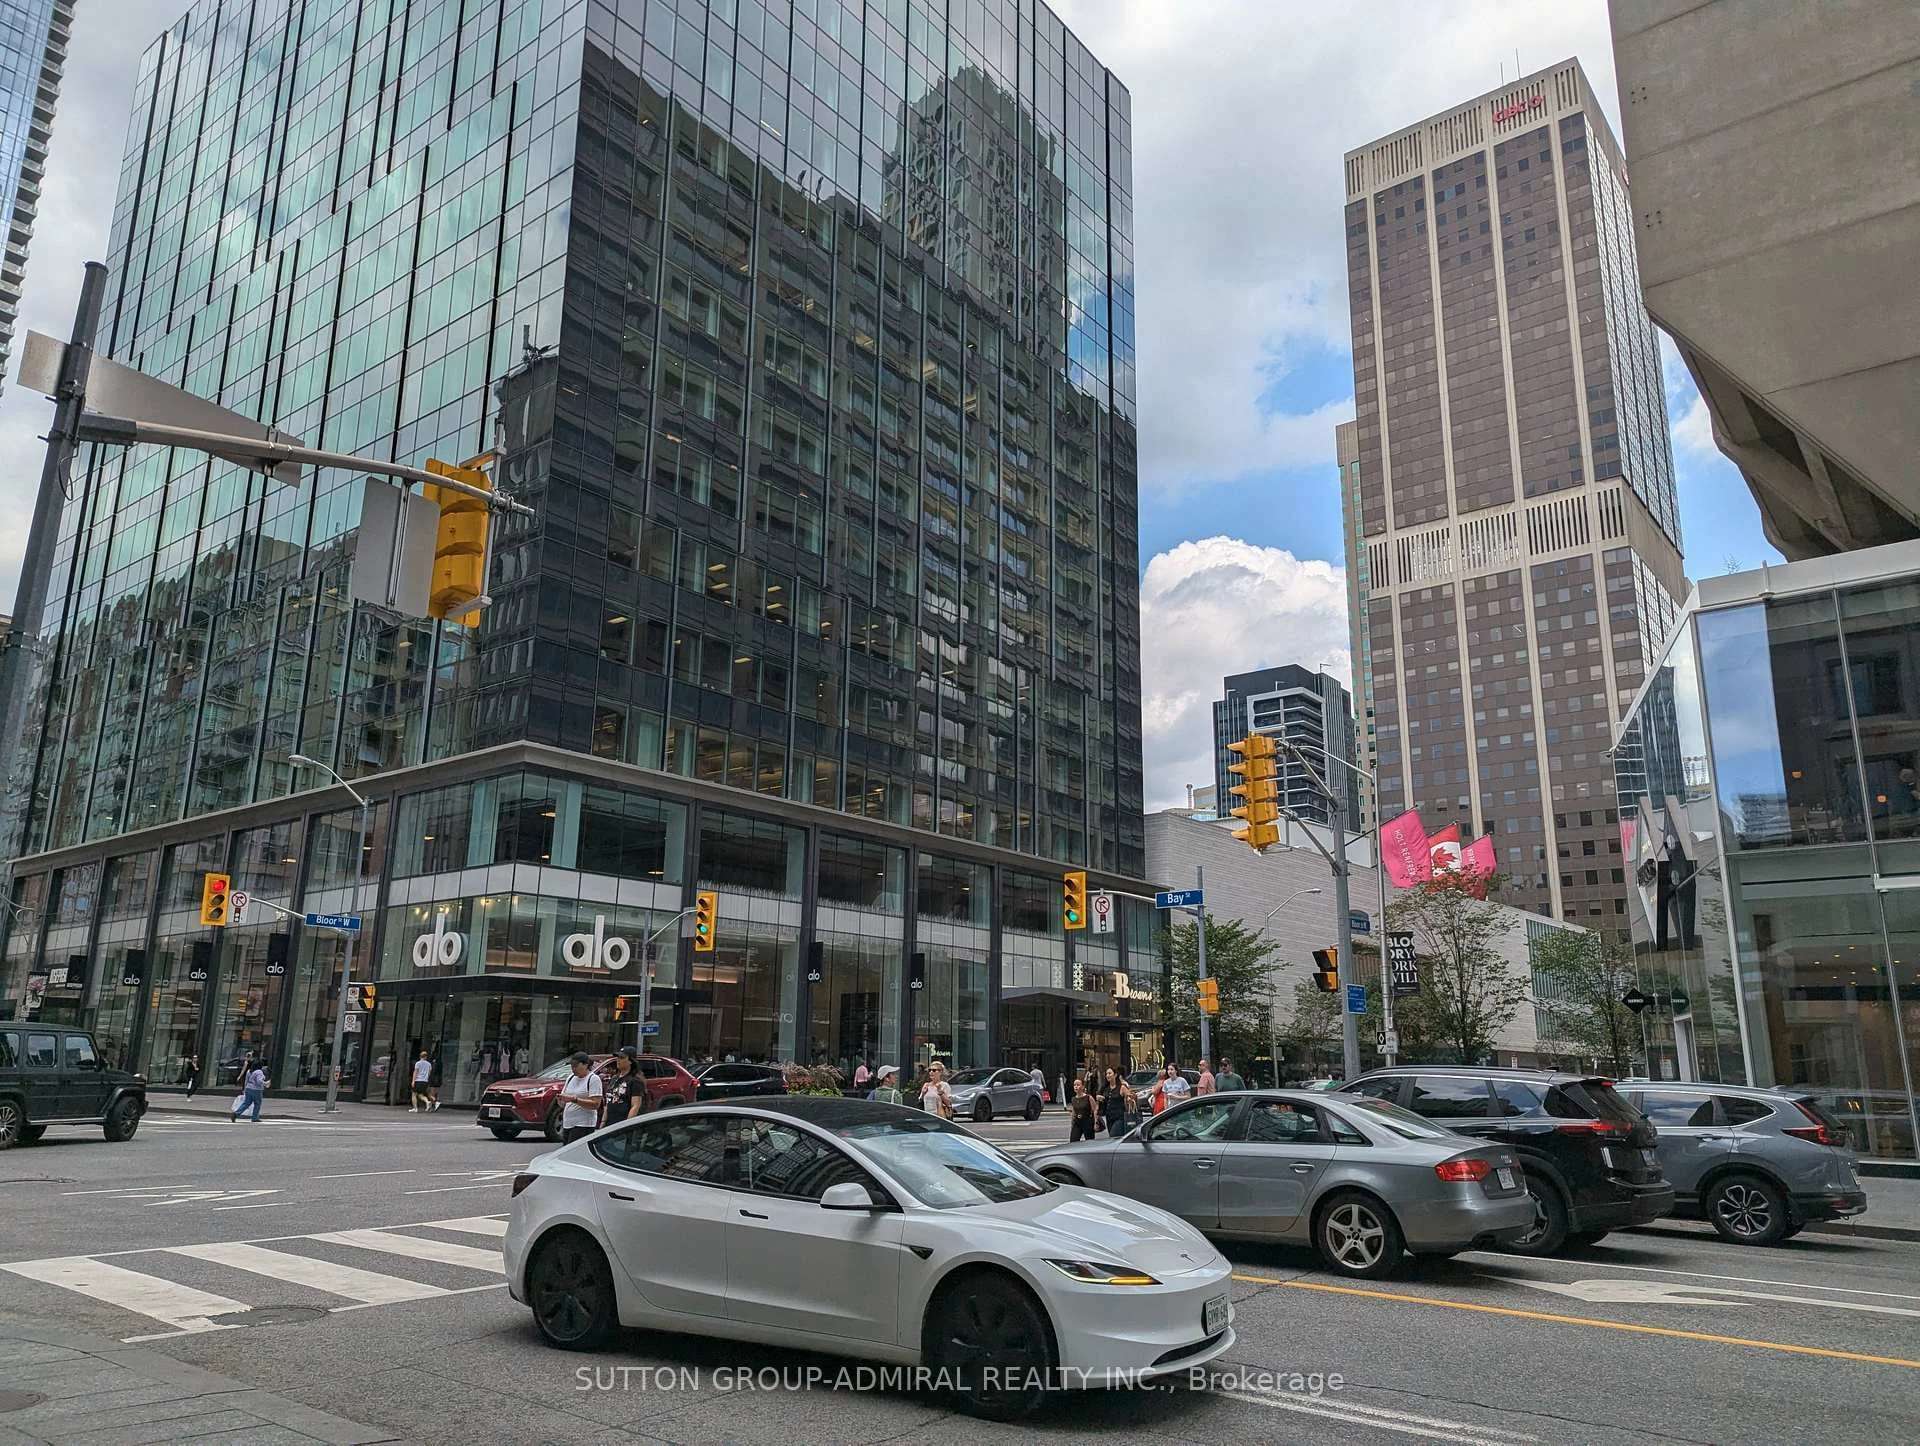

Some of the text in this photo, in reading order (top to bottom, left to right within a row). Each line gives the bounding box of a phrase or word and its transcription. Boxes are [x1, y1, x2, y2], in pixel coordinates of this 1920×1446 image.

[1167, 893, 1184, 905] Bay
[316, 915, 337, 926] Bloor
[343, 917, 351, 927] W
[412, 912, 463, 968] alo
[562, 914, 631, 971] alo
[190, 968, 207, 980] alo
[266, 961, 284, 975] alo
[123, 974, 141, 985] alo
[807, 968, 820, 981] alo
[910, 978, 923, 989] alo
[1112, 971, 1153, 1001] Browns
